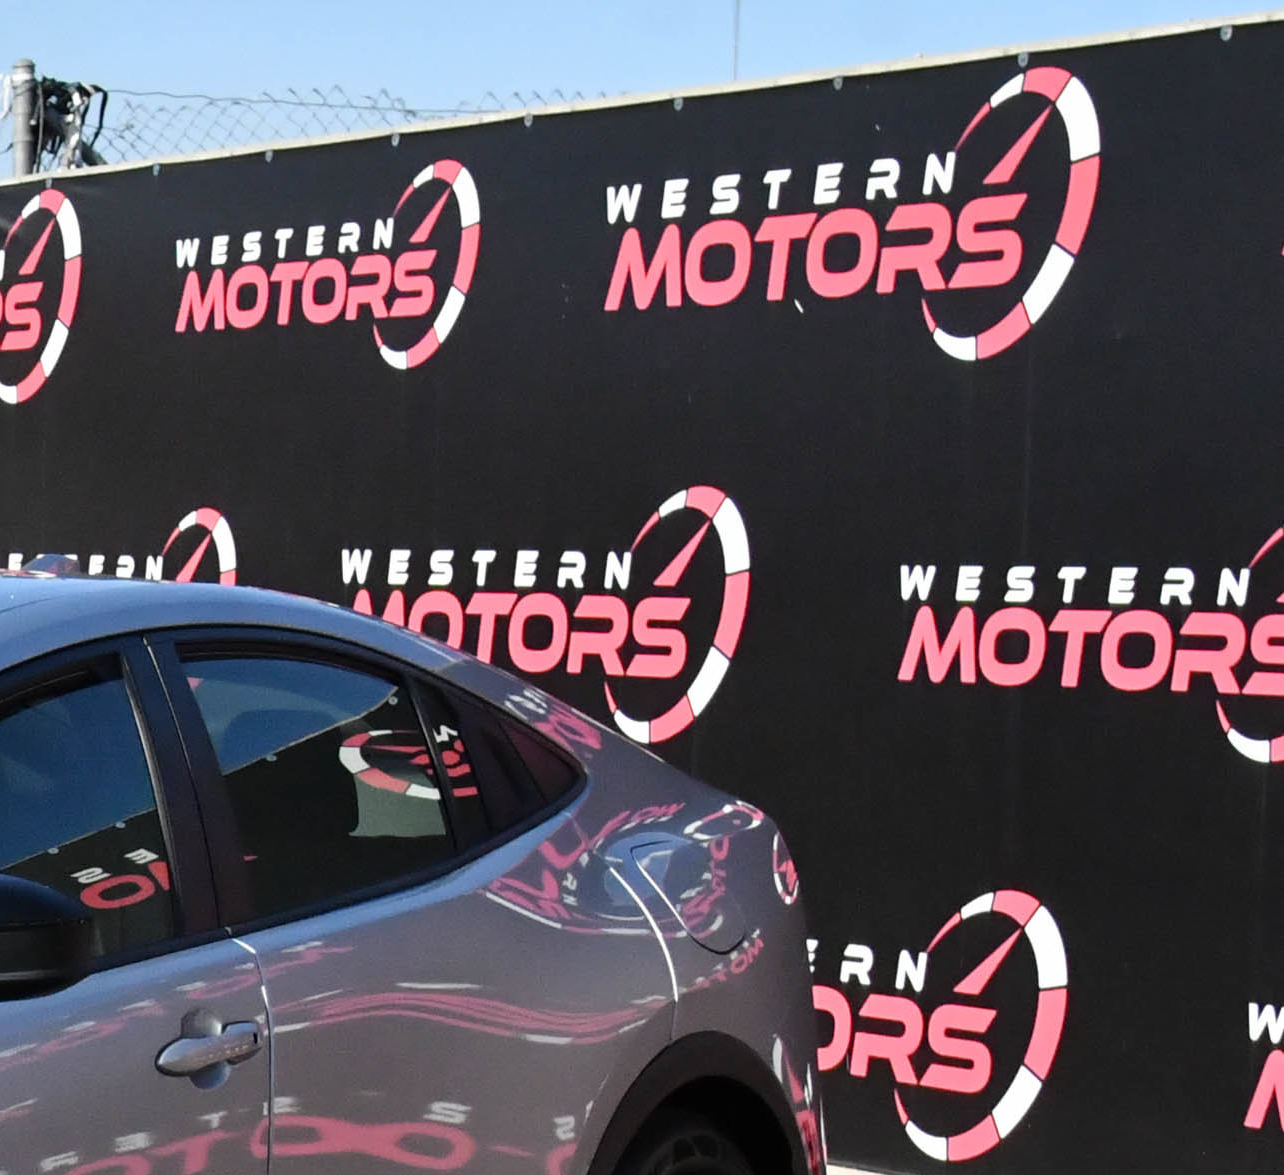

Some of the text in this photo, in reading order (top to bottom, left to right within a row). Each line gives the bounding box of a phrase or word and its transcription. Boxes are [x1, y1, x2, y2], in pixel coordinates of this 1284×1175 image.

[605, 152, 957, 225] WESTERN
[175, 217, 395, 268] WESTERN
[603, 193, 1028, 312] MOTORS
[174, 248, 437, 333] MOTORS
[341, 549, 632, 590] WESTERN
[899, 564, 1251, 607] WESTERN
[897, 605, 1284, 697] MOTORS
